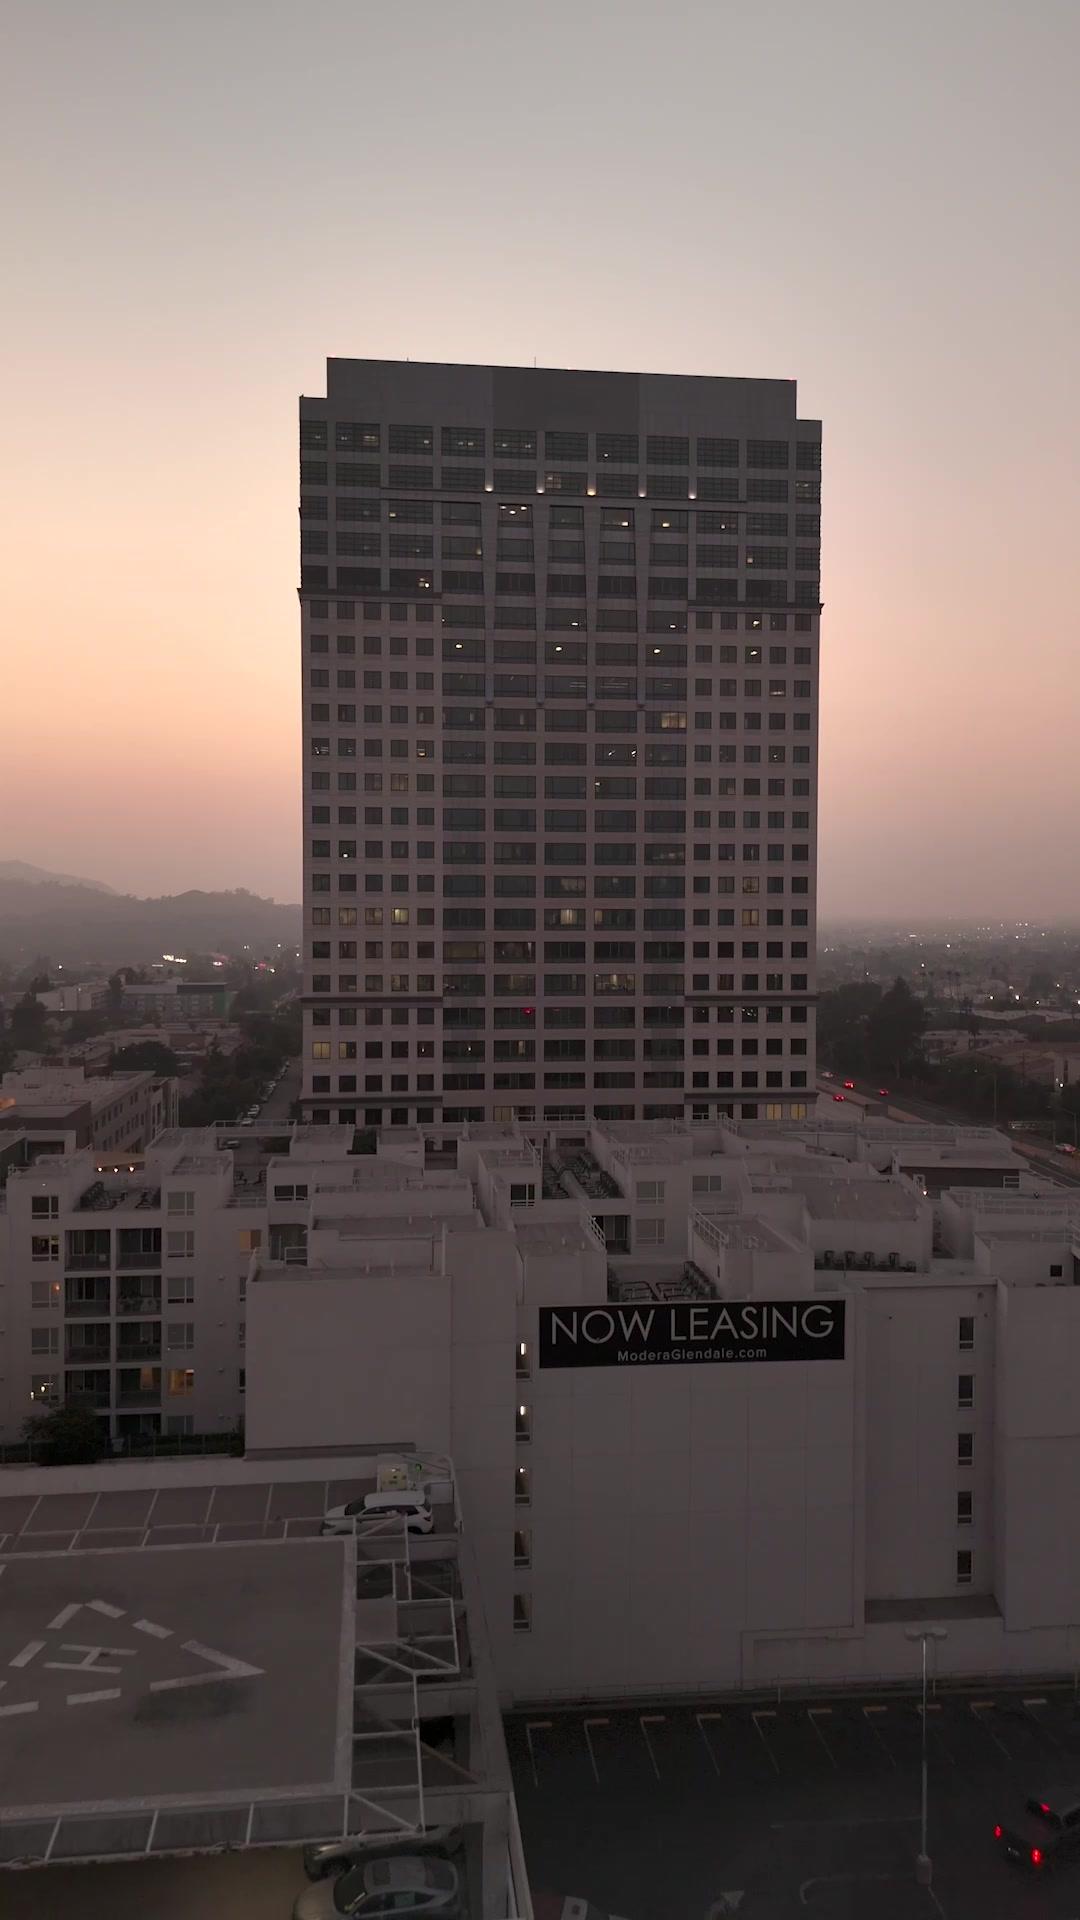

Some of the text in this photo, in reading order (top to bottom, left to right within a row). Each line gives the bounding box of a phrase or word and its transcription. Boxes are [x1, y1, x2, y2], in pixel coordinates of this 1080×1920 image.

[550, 1304, 835, 1345] NOW LEASING
[616, 1348, 768, 1363] ModeraGlendale.com
[43, 1642, 138, 1674] H
